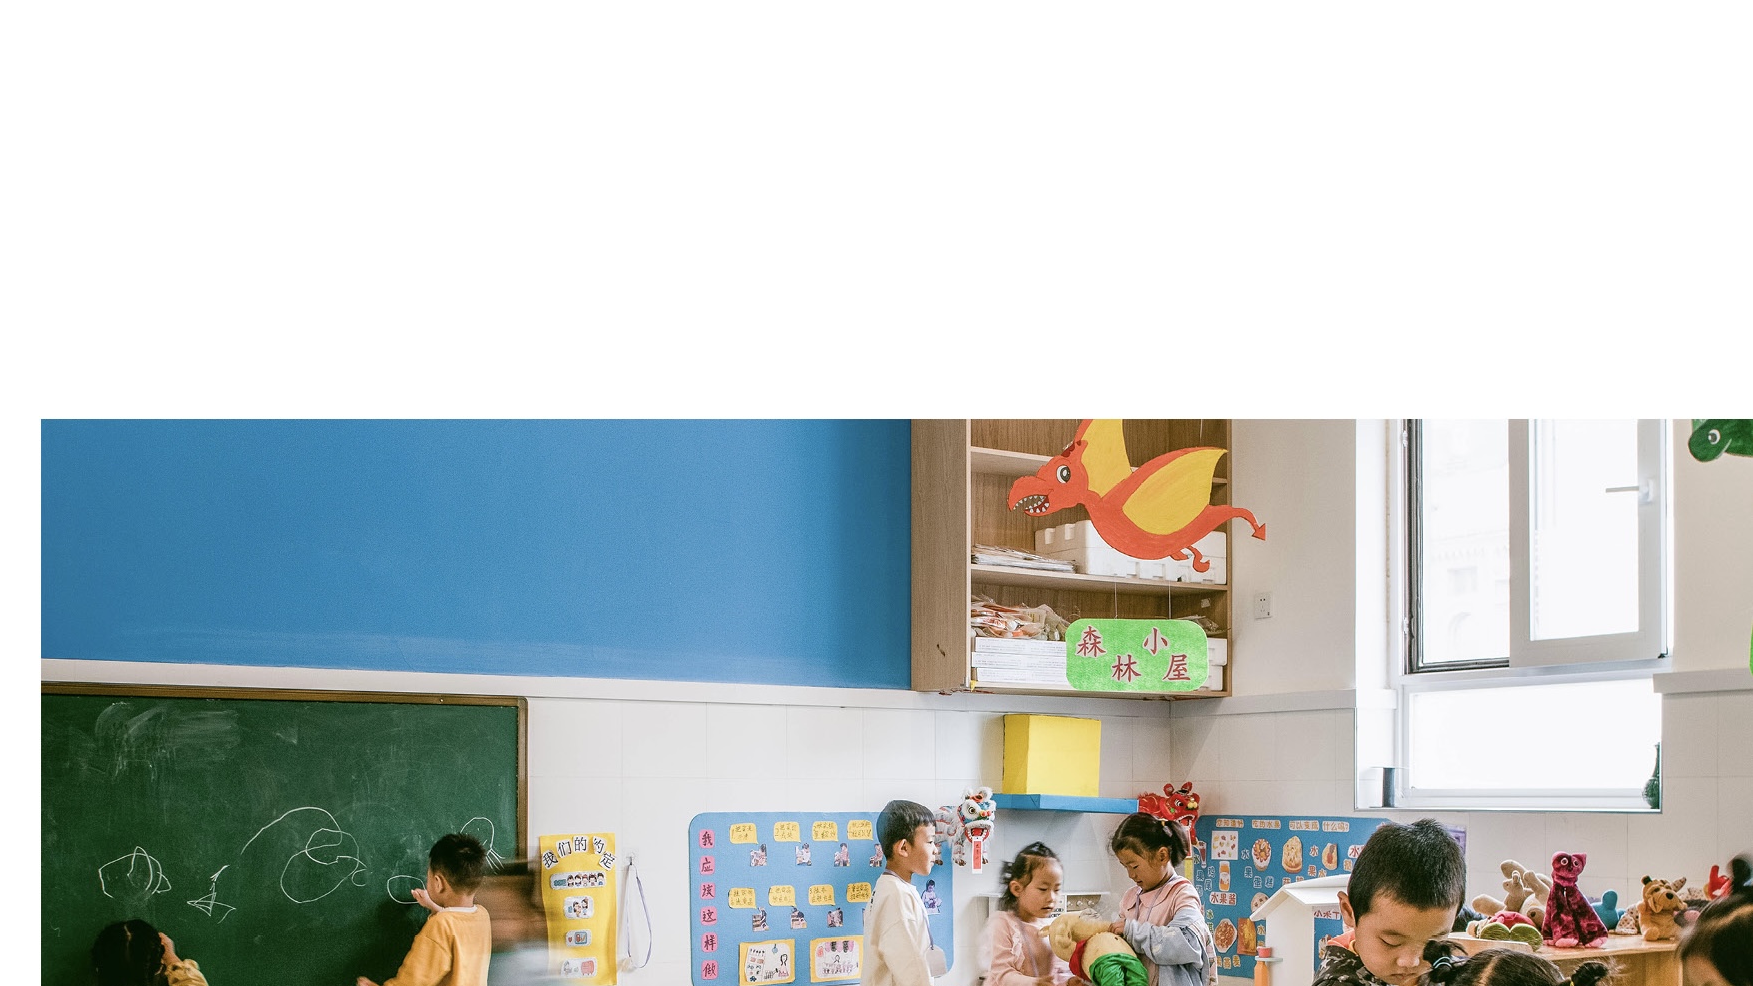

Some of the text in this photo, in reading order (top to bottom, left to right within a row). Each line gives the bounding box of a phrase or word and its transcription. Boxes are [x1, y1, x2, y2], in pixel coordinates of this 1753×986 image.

[1076, 625, 1191, 682] 森林小屋
[543, 835, 616, 869] 我们的约定
[701, 830, 717, 978] 我应该这样做
[1210, 892, 1236, 905] 水果酱
